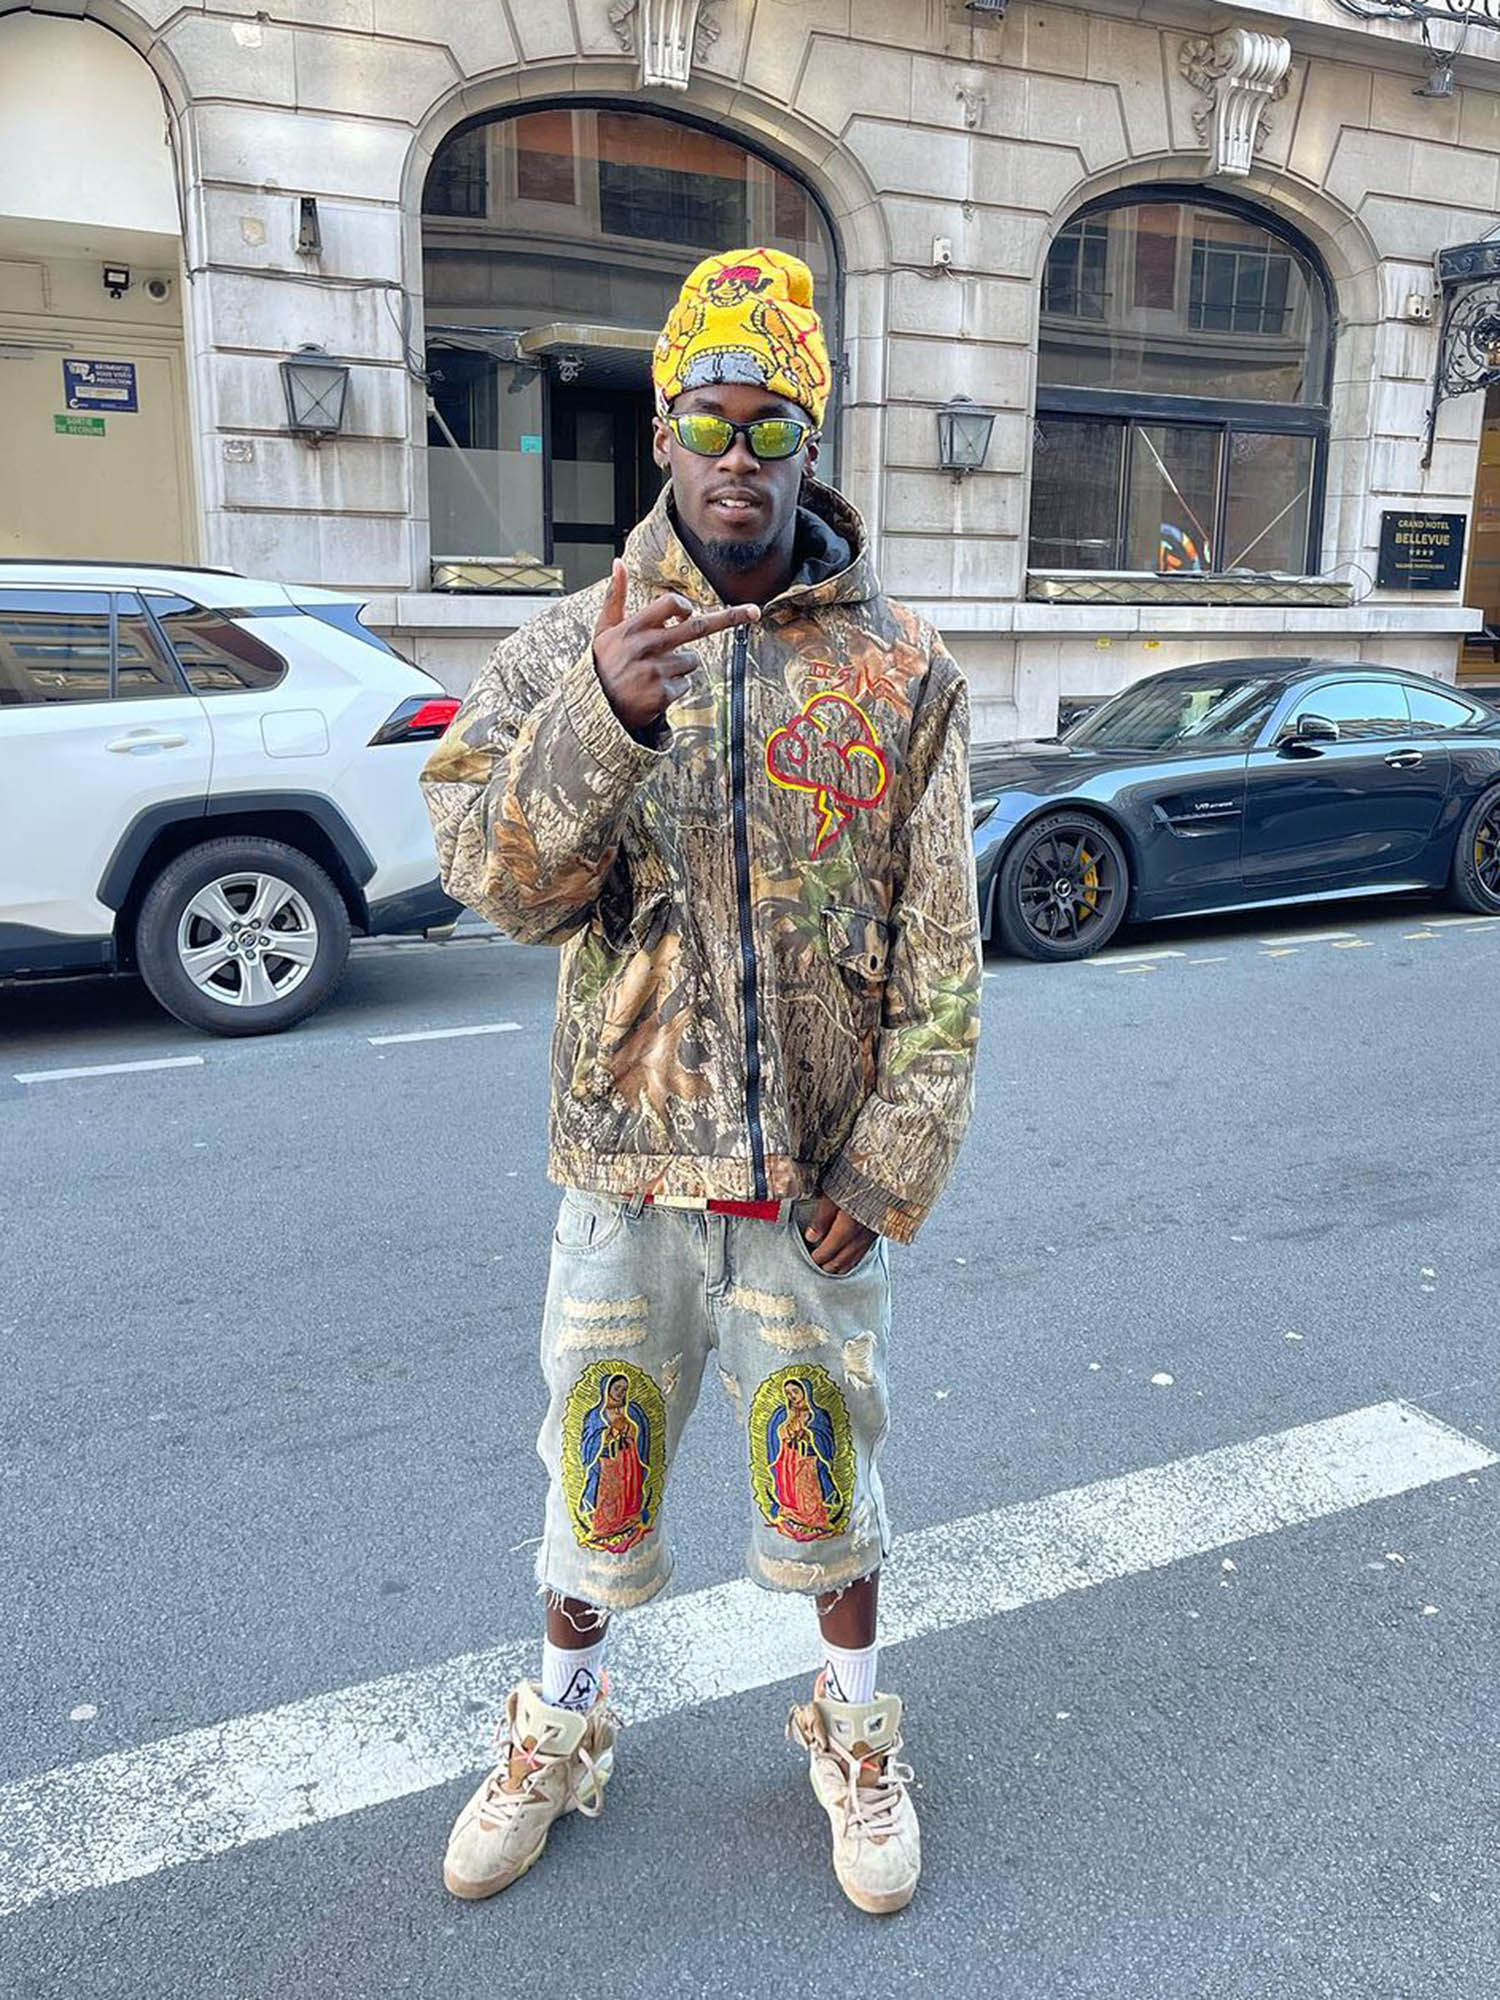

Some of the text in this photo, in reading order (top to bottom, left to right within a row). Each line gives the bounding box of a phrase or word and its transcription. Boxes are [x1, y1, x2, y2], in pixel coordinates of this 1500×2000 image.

[1398, 519, 1450, 530] GRAND HOTEL
[1395, 532, 1450, 546] BELLEVUE
